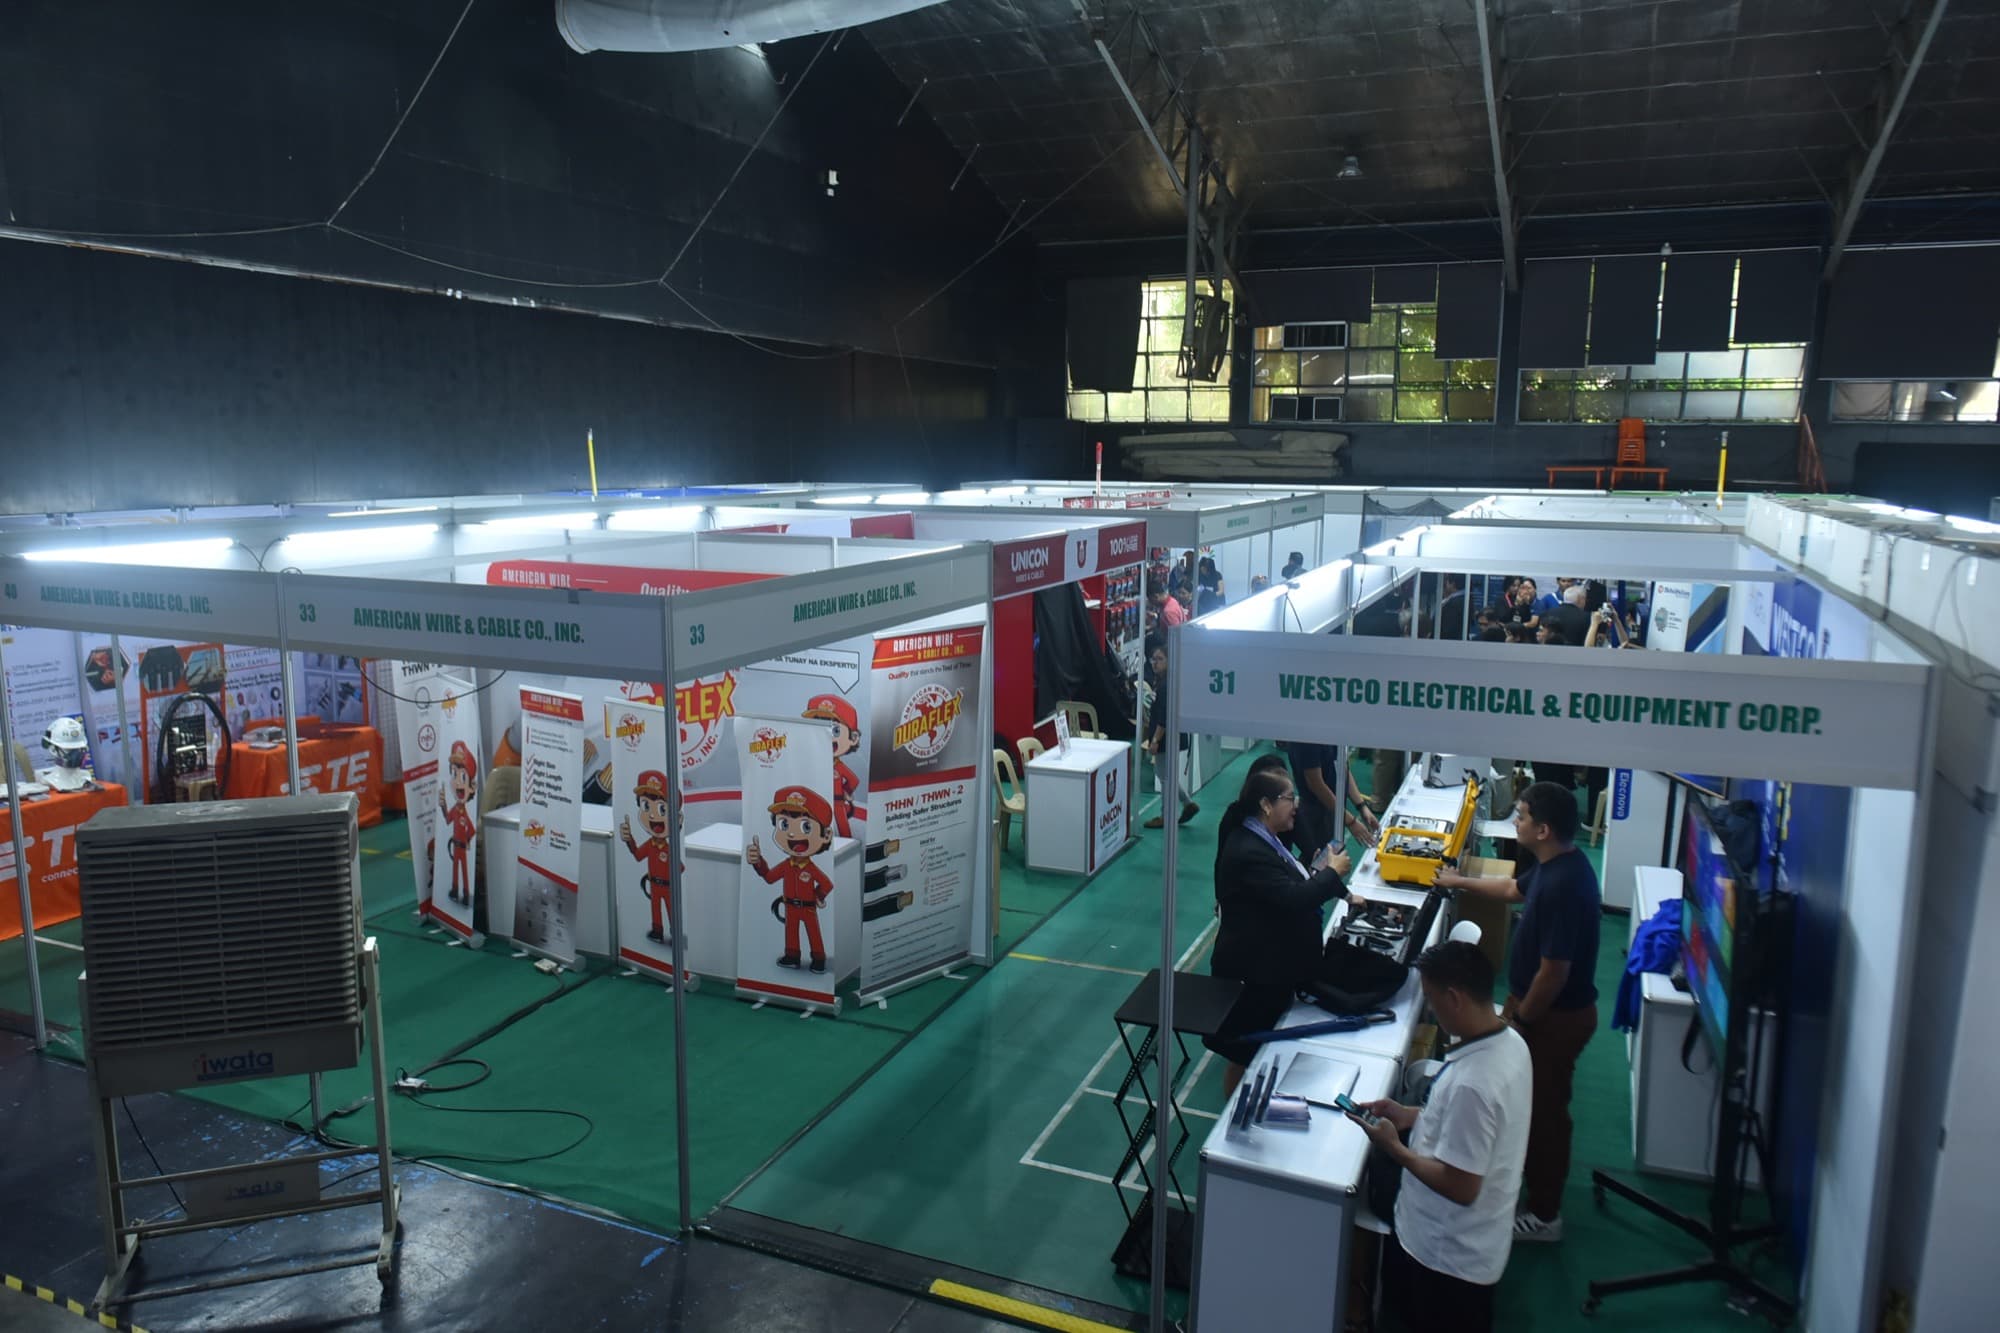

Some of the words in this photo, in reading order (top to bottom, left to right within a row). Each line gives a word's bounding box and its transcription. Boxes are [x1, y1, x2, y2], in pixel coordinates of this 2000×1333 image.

[1011, 547, 1049, 572] UNICON
[502, 569, 546, 585] AMERICAN
[549, 573, 571, 587] WIRE
[41, 585, 93, 604] AMERICAN
[94, 588, 121, 607] WIRE
[122, 594, 131, 608] &
[133, 592, 165, 611] CABLE
[167, 594, 189, 613] CO.,
[190, 596, 214, 615] INC.
[794, 595, 837, 622] AMERICAN
[838, 591, 858, 612] WIRE
[859, 593, 866, 608] &
[867, 588, 889, 605] CABLE
[902, 581, 917, 597] INC.
[299, 603, 316, 623] 33
[354, 608, 422, 631] AMERICAN
[425, 612, 462, 634] WIRE
[464, 618, 475, 635] &
[478, 616, 521, 639] CABLE
[524, 620, 551, 642] CO.,
[554, 622, 585, 643] INC.
[690, 624, 705, 646] 33
[893, 635, 933, 653] AMERICAN
[935, 633, 954, 646] WIRE
[402, 662, 430, 677] THWN
[785, 656, 807, 665] TUNAY
[808, 658, 818, 666] NA
[820, 659, 858, 670] EKSPERTO!
[888, 670, 909, 681] Quality
[1209, 669, 1236, 695] 31
[904, 686, 932, 719] AMERICAN
[934, 686, 949, 698] WIRE
[1279, 673, 1381, 705] WESTCO
[1387, 680, 1535, 716] ELECTRICAL
[1542, 694, 1562, 718] &
[1568, 692, 1732, 729] EQUIPMENT
[1738, 702, 1824, 735] CORP.
[893, 689, 962, 751] DURAFLEX
[700, 734, 719, 757] INC.
[913, 747, 931, 756] CABLE
[326, 751, 370, 791] TE
[885, 796, 913, 813] THHN
[921, 788, 951, 803] THWN
[957, 784, 964, 794] 2
[1616, 771, 1630, 817] Elecnova
[886, 812, 911, 823] Building
[930, 799, 962, 811] Structures
[1100, 802, 1122, 830] UNICON
[42, 822, 79, 868] T
[41, 867, 79, 883] connec
[200, 1050, 273, 1073] iwata
